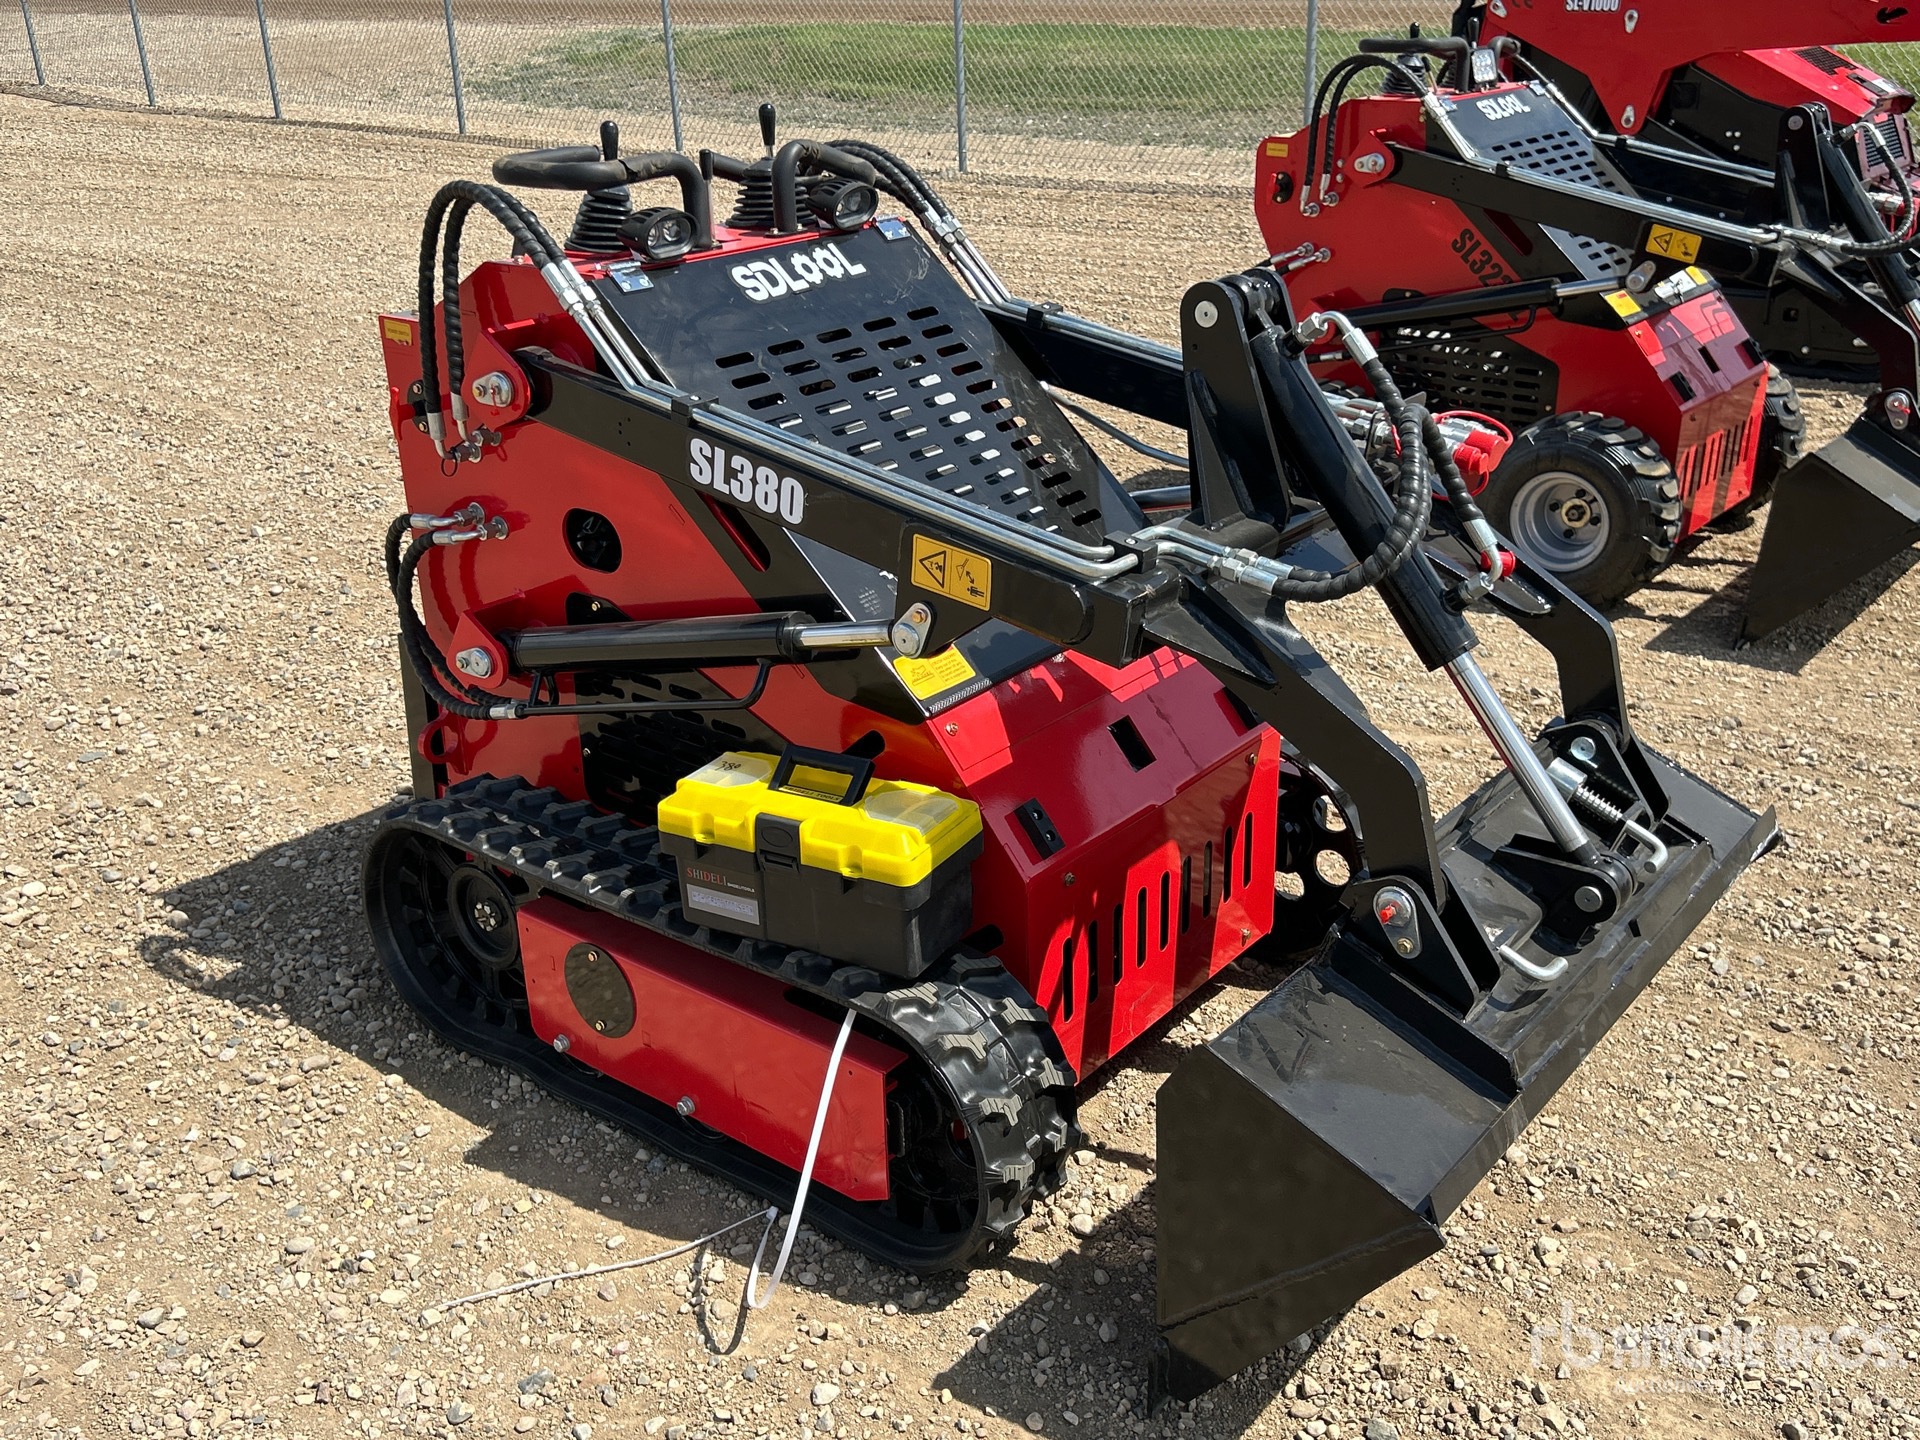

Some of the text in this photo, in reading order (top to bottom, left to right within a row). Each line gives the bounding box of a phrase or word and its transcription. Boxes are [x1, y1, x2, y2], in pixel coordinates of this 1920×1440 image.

[731, 242, 867, 301] SDLOOL
[690, 438, 804, 525] SL380
[714, 760, 741, 771] 380
[687, 867, 727, 886] SHIDELI
